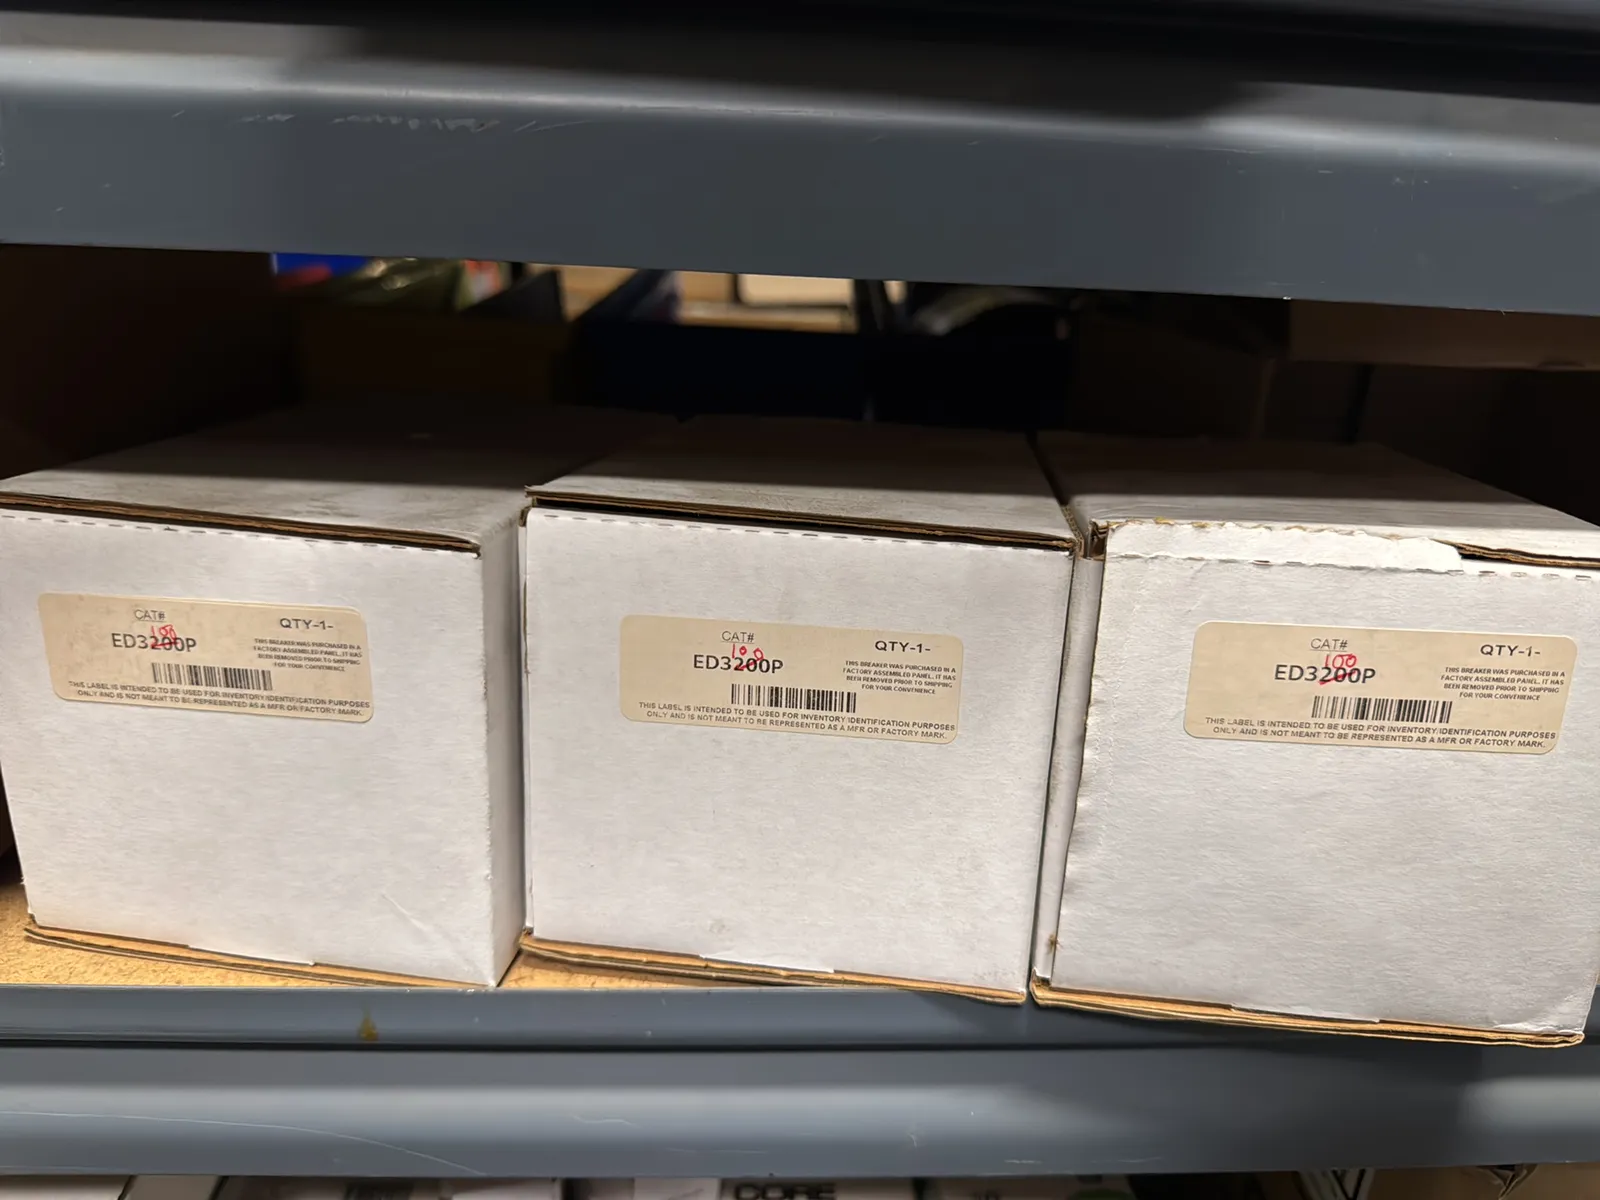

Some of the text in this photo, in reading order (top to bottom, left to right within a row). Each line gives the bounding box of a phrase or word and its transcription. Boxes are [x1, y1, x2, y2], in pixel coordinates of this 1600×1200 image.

[135, 609, 165, 620] CAT#
[280, 618, 334, 630] QTY-1-
[112, 633, 196, 652] ED3200P
[722, 631, 754, 642] CAT#
[875, 640, 931, 653] QTY-1-
[1311, 638, 1348, 650] CAT#
[1480, 644, 1541, 657] QTY-1-
[694, 655, 783, 673] ED3200P
[860, 661, 889, 669] BREAKER
[905, 664, 942, 672] PURCHASED
[1275, 664, 1375, 683] ED3200P
[893, 686, 936, 694] CONVENIENCE
[1494, 693, 1540, 701] CONVENIENCE
[658, 703, 682, 711] LABEL
[693, 706, 732, 715] INTENDED
[733, 708, 744, 716] TO
[746, 709, 757, 717] BE
[759, 710, 780, 718] USED
[782, 712, 798, 720] FOR
[800, 713, 845, 723] INVENTORY
[848, 717, 910, 728] IDENTIFICATION
[912, 721, 955, 731] PURPOSES
[646, 711, 668, 719] ONLY
[670, 712, 686, 720] AND
[687, 713, 695, 721] IS
[697, 714, 713, 722] NOT
[715, 715, 742, 724] MEANT
[769, 719, 825, 730] REPRESENTED
[846, 725, 865, 733] MFR
[881, 728, 918, 737] FACTORY
[921, 730, 947, 739] MARK.
[1205, 717, 1225, 725] THIS
[1227, 718, 1254, 726] LABEL
[1257, 719, 1265, 727] IS
[1267, 720, 1311, 729] INTENDED
[1327, 722, 1338, 730] BE
[1341, 723, 1364, 731] USED
[1366, 724, 1385, 732] FOR
[1387, 725, 1437, 734] INVENTORY
[1439, 727, 1507, 737] IDENTIFICATION
[1509, 730, 1556, 739] PURPOSES
[1213, 727, 1236, 735] ONLY
[1239, 728, 1258, 736] AND
[1259, 728, 1268, 736] IS
[1270, 729, 1288, 737] NOT
[1290, 730, 1321, 738] MEANT
[1323, 731, 1335, 739] TO
[1351, 732, 1413, 742] REPRESENTED
[1415, 735, 1427, 743] AS
[1429, 735, 1435, 743] A
[1437, 736, 1457, 744] MFR
[1459, 737, 1472, 745] OR
[1474, 737, 1516, 747] FACTORY
[1517, 739, 1546, 748] MARK.
